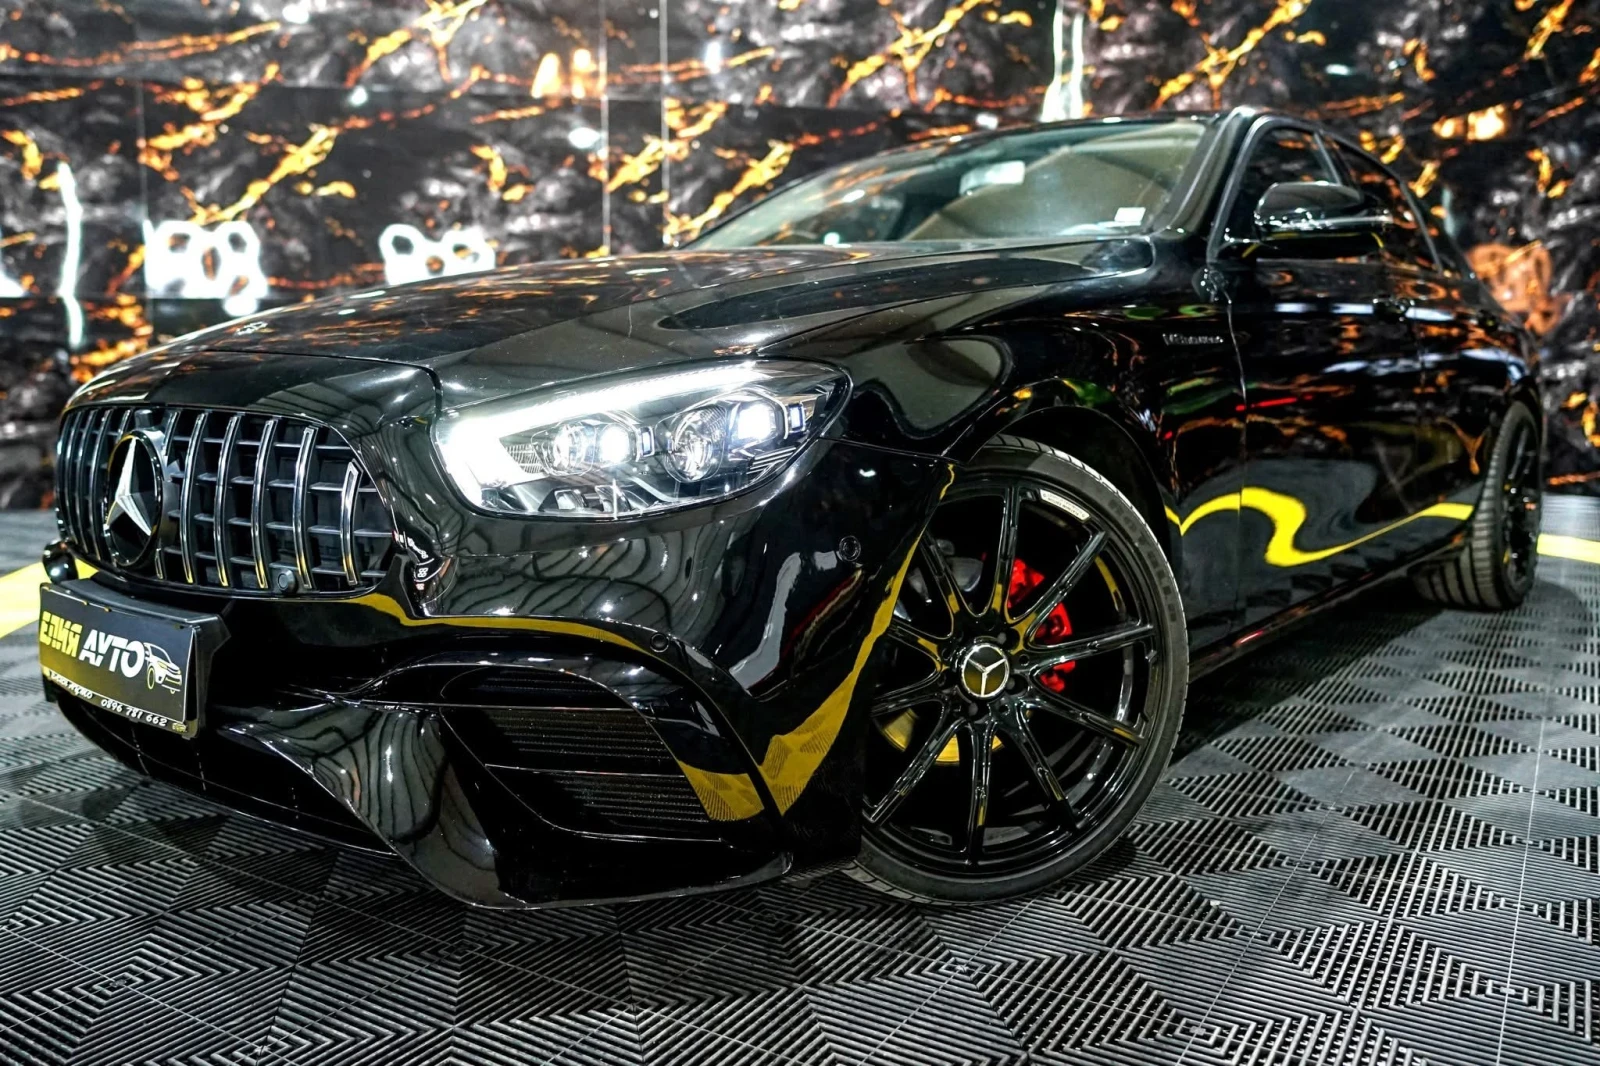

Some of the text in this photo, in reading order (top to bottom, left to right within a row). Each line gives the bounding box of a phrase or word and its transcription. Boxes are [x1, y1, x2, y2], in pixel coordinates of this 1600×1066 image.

[100, 699, 168, 727] 0896 781 662
